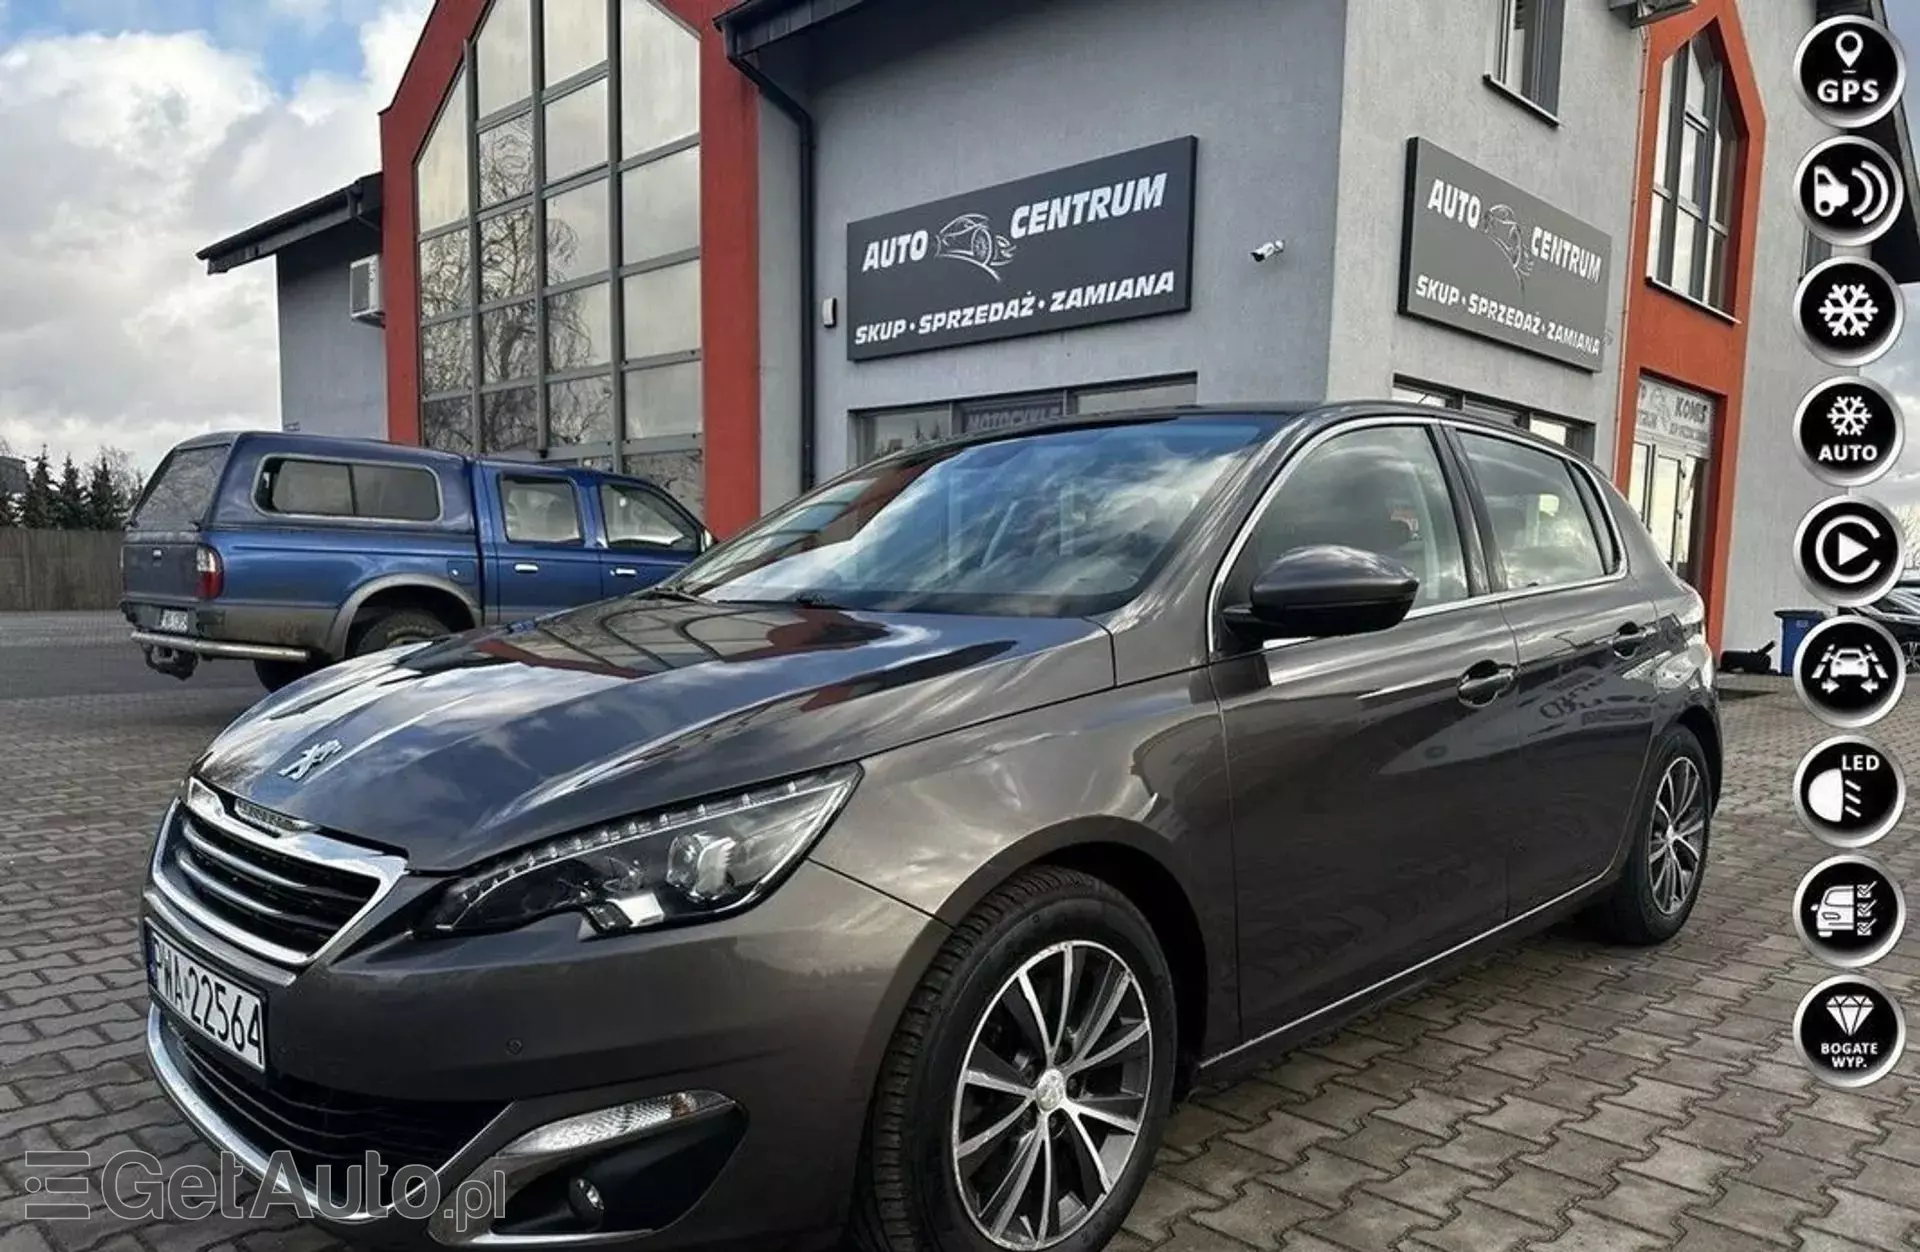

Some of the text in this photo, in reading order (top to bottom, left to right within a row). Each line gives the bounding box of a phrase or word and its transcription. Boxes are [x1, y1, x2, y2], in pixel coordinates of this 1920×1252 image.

[862, 172, 1168, 273] AUTO CENTRUM
[1427, 178, 1602, 284] AUTO CENTRUM
[855, 271, 1174, 346] SKUP SPRZEDAŻ ZAMIANA
[1415, 274, 1601, 356] SKUP SPRZEDAŻ ZAMIANA
[188, 966, 263, 1065] 22564
